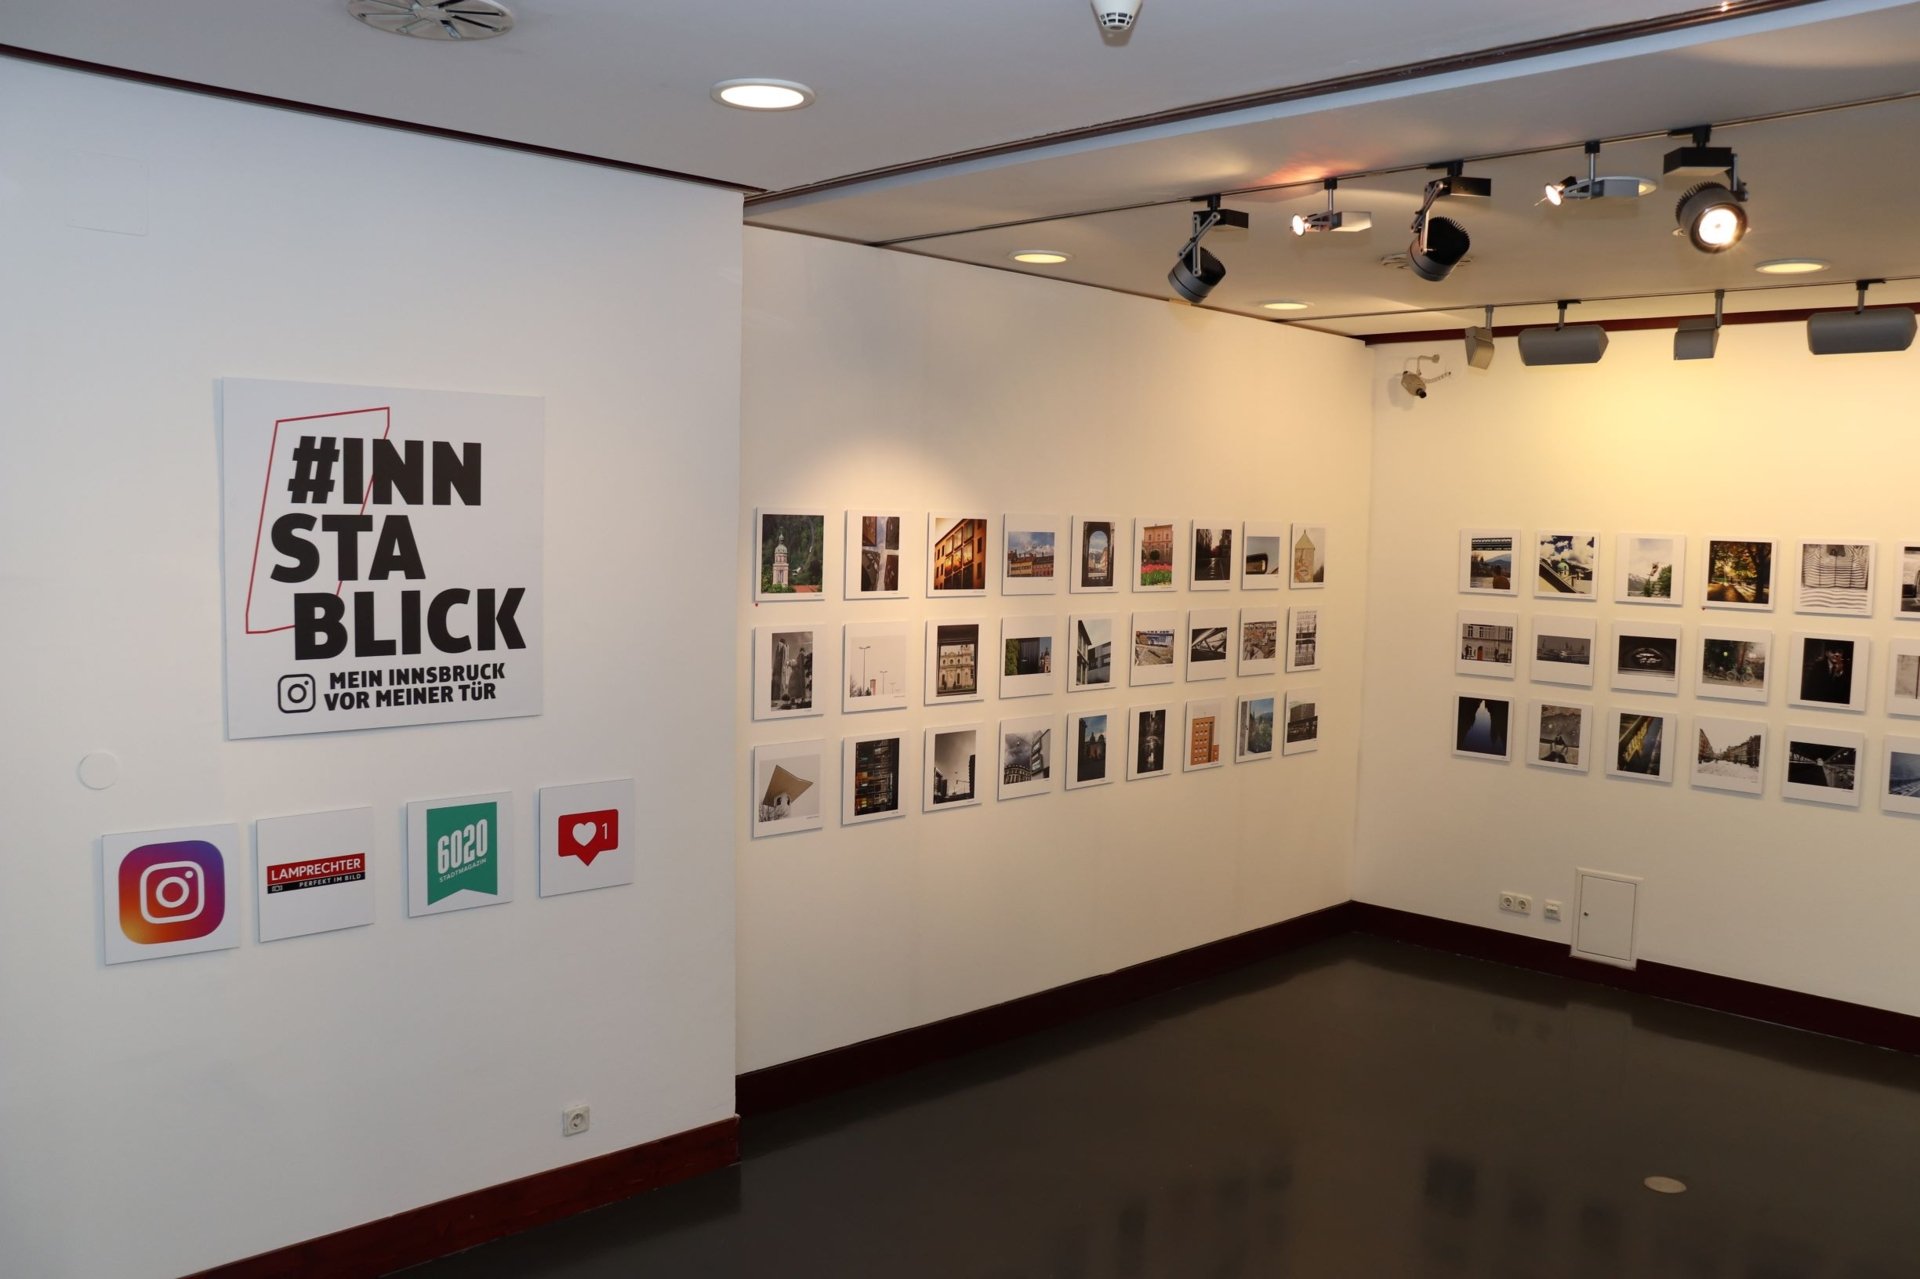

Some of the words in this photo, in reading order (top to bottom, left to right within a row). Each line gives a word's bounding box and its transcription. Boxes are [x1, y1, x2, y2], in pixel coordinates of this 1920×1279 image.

[287, 436, 482, 506] #INN
[270, 513, 426, 584] STA
[293, 587, 527, 661] BLICK
[330, 670, 383, 690] MEIN
[388, 663, 506, 687] INNSBRUCK
[324, 692, 370, 711] VOR
[376, 685, 454, 708] MEINER
[458, 682, 497, 701] TÜR
[602, 822, 608, 840] 1
[437, 819, 488, 874] 6020
[271, 858, 361, 881] LAMPRECHTER
[298, 878, 332, 888] PERFEKT
[333, 876, 343, 884] IM
[344, 873, 362, 882] BILD
[439, 858, 487, 883] STADTMAGAZIN
